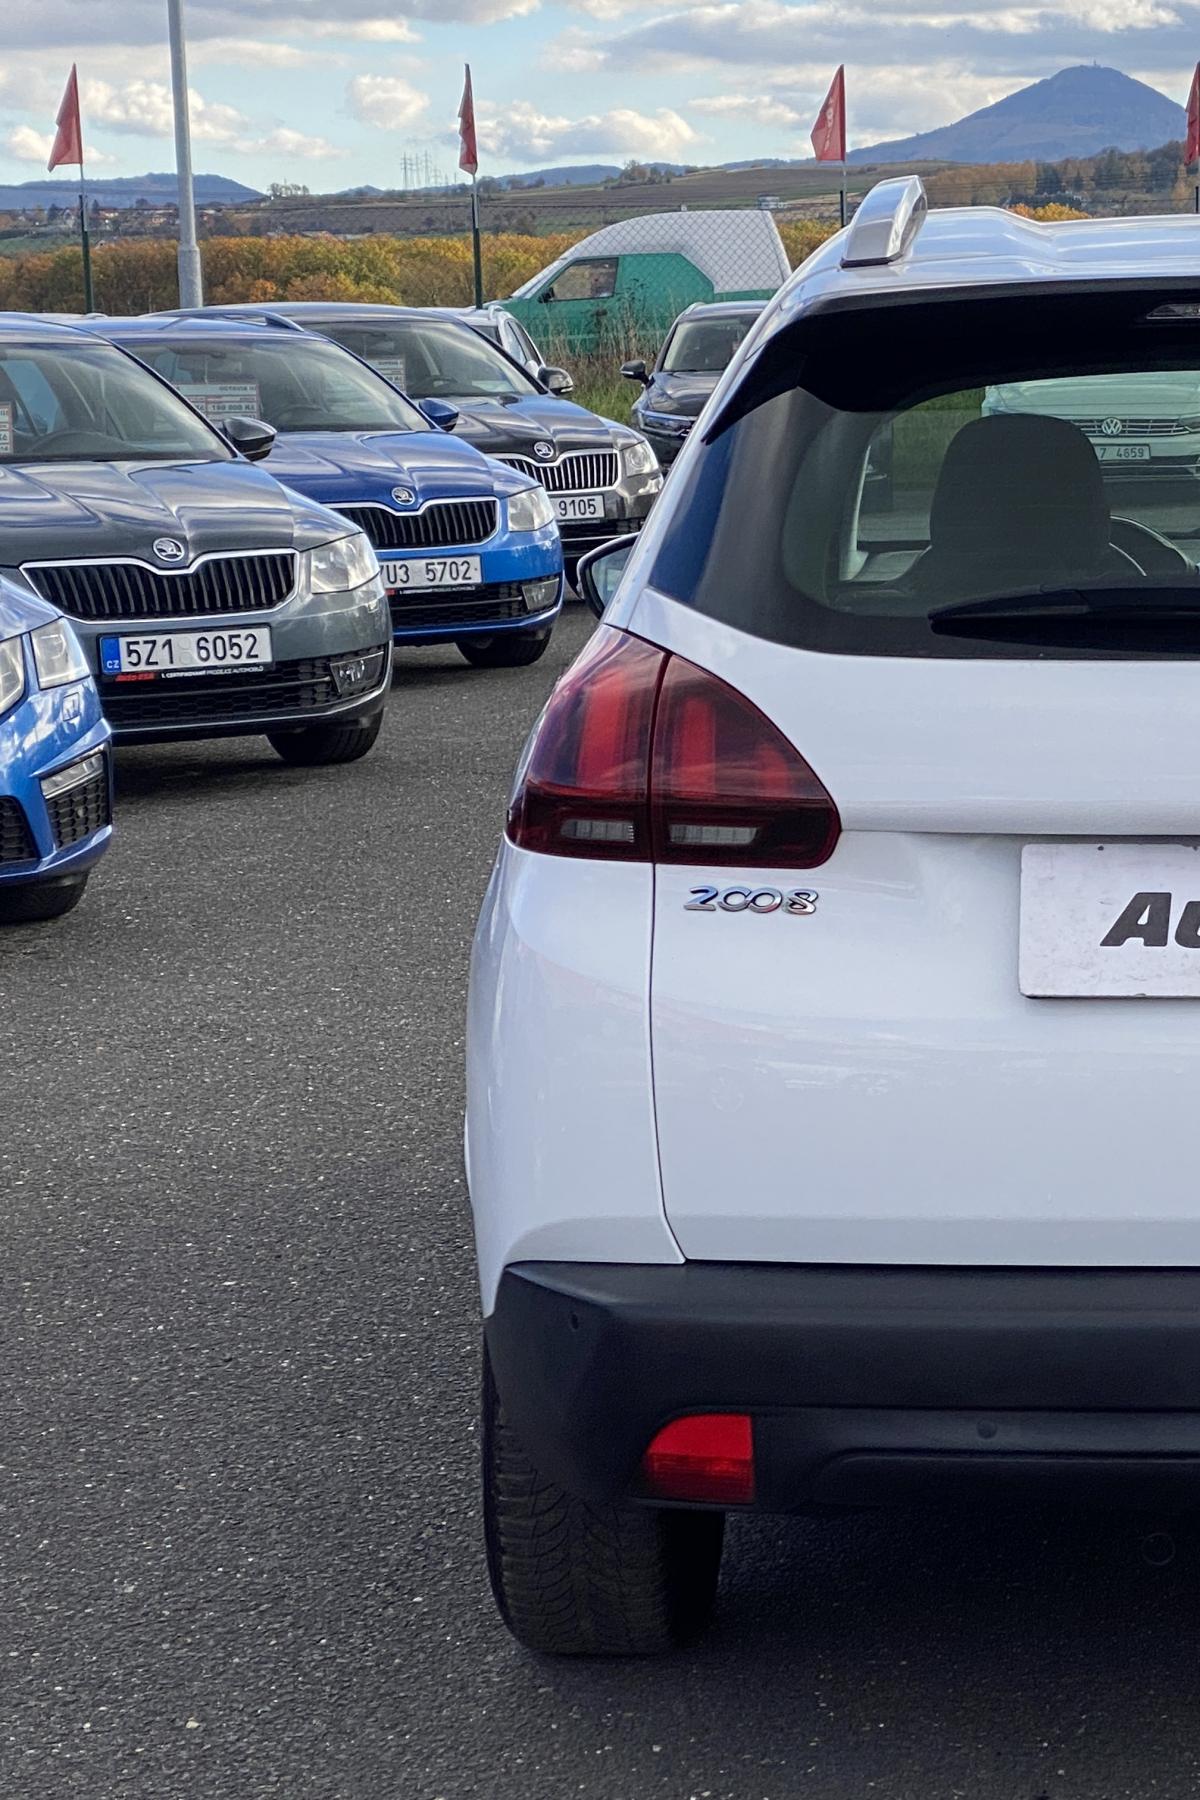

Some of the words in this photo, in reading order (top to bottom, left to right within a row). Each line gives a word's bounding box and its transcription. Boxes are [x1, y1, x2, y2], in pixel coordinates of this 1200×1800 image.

[1116, 447, 1144, 458] 4659
[558, 498, 597, 517] 9105
[425, 560, 472, 582] 5702
[125, 637, 175, 668] 5Z1
[196, 632, 259, 663] 6052
[106, 660, 120, 669] CZ
[683, 885, 819, 915] 2008
